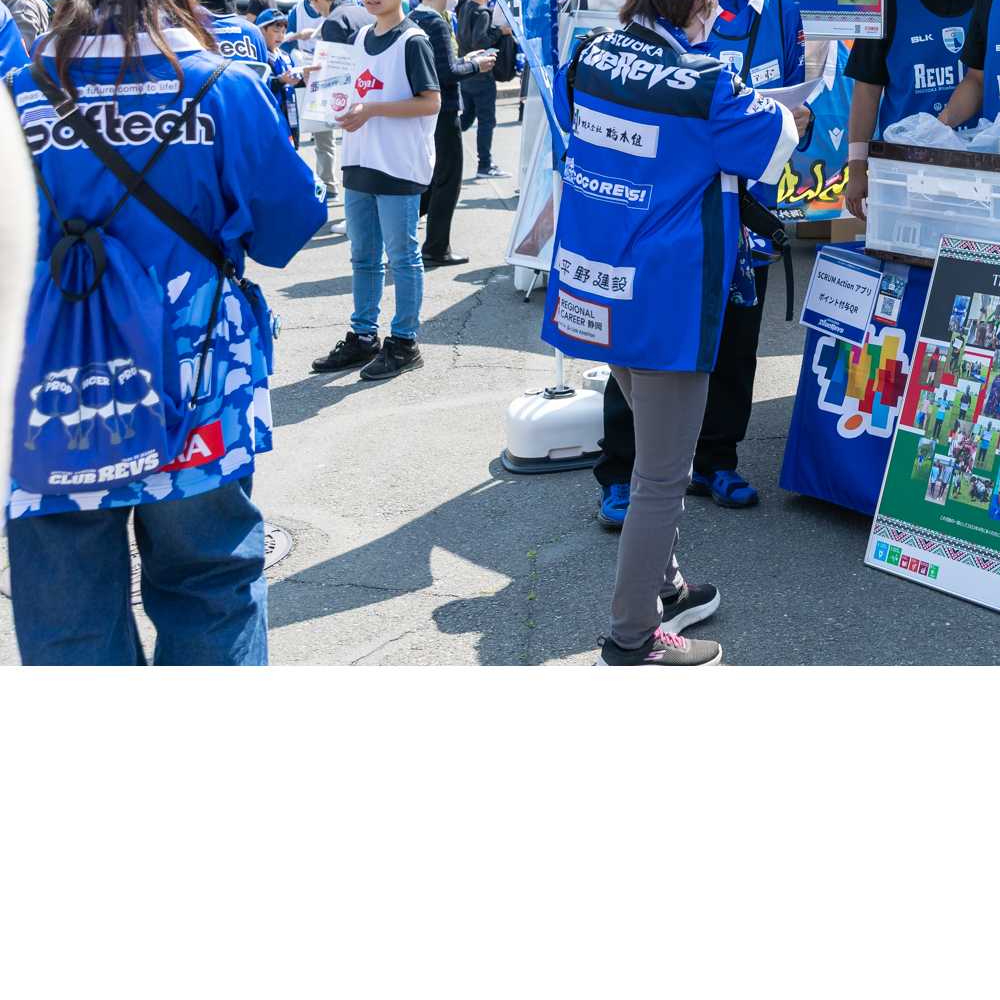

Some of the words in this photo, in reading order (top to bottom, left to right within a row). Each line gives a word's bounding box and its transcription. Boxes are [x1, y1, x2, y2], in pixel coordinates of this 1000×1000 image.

[558, 258, 629, 293] 平野建設
[817, 271, 837, 284] SCRUM
[836, 276, 855, 290] Action
[854, 284, 873, 297] アプリ
[560, 298, 595, 319] REGIONAL
[819, 293, 859, 314] ポイント付与QR
[560, 309, 586, 326] CAREER
[45, 380, 73, 395] PROP
[48, 473, 97, 485] CLUB
[98, 452, 160, 482] REVS
